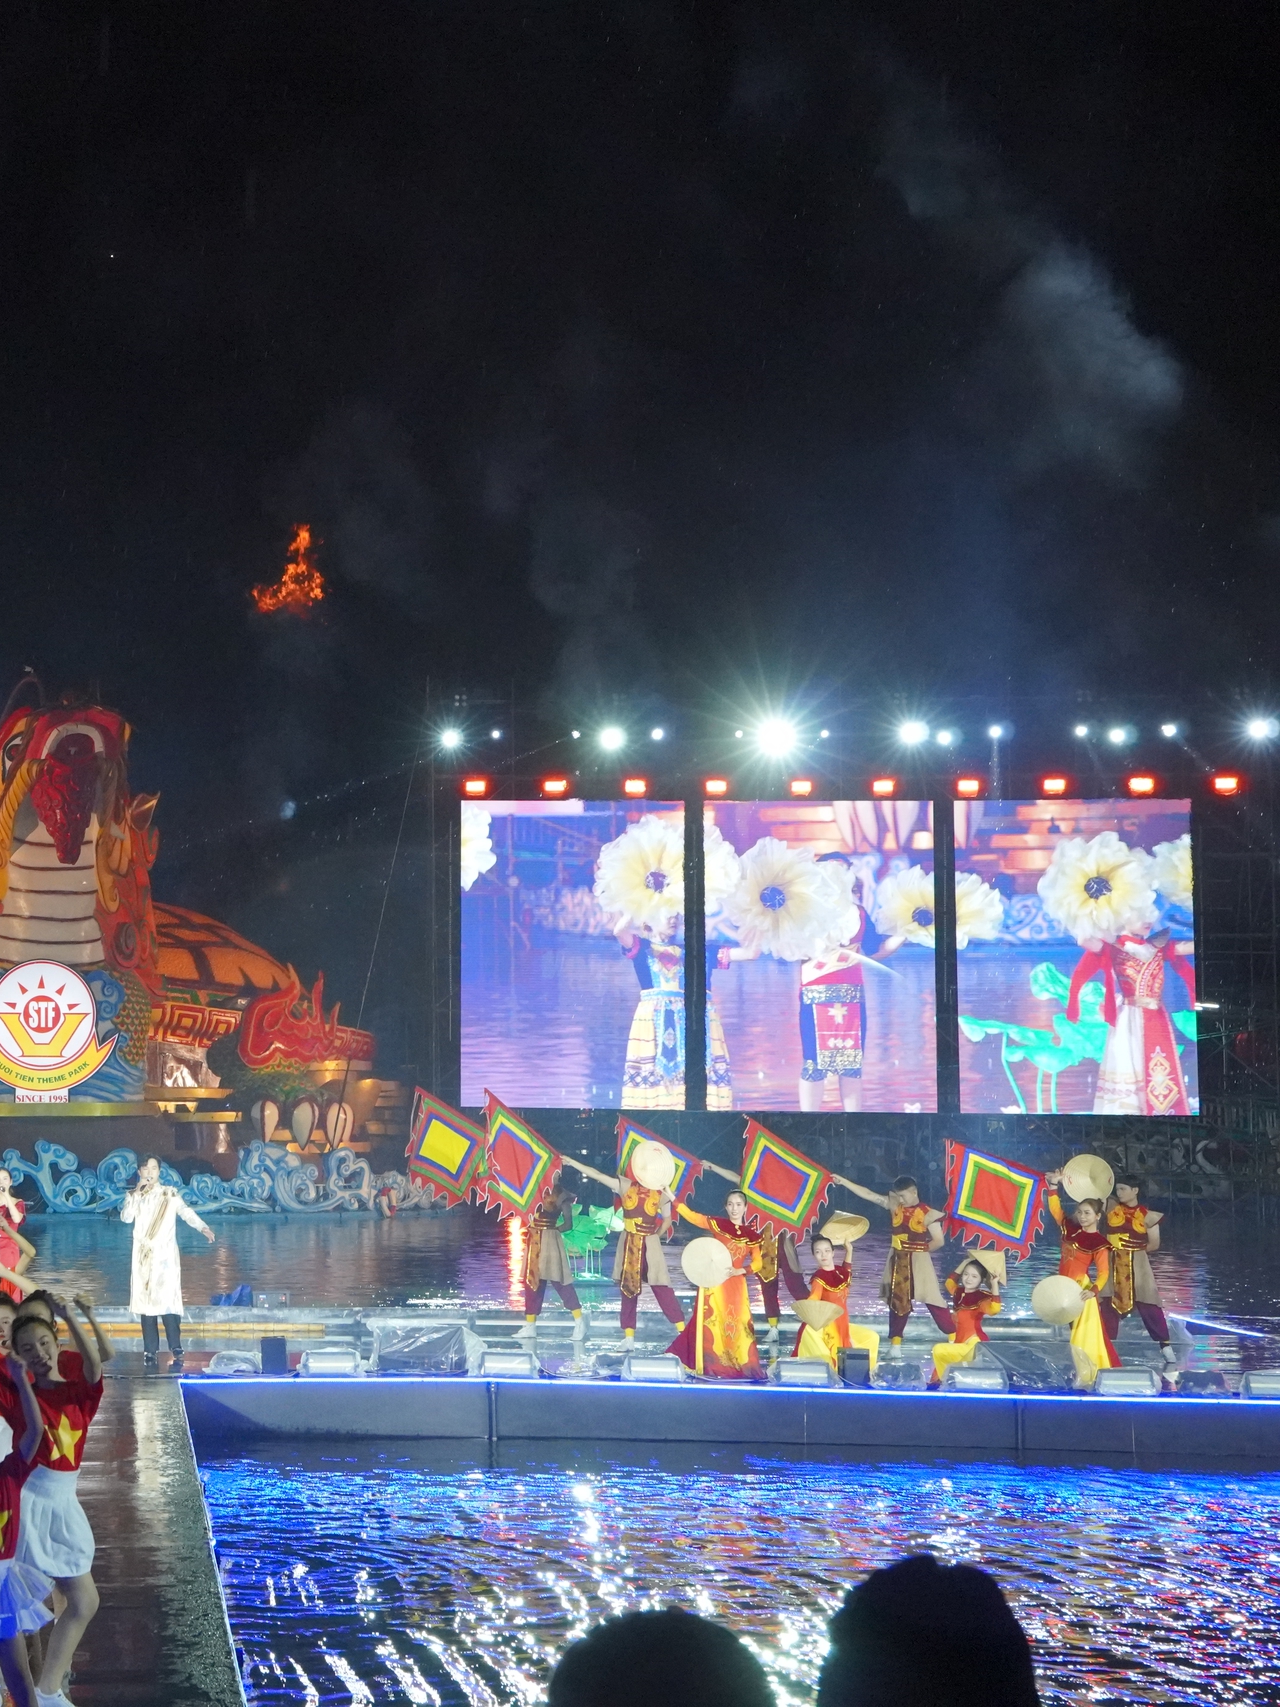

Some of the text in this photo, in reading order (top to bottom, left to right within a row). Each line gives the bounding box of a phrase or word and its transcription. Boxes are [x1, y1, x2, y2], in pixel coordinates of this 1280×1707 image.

[28, 1001, 56, 1028] STF
[14, 1072, 34, 1083] TIEN
[37, 1074, 67, 1084] THEME
[68, 1061, 90, 1077] PARK
[16, 1095, 68, 1103] SINCE 1995
